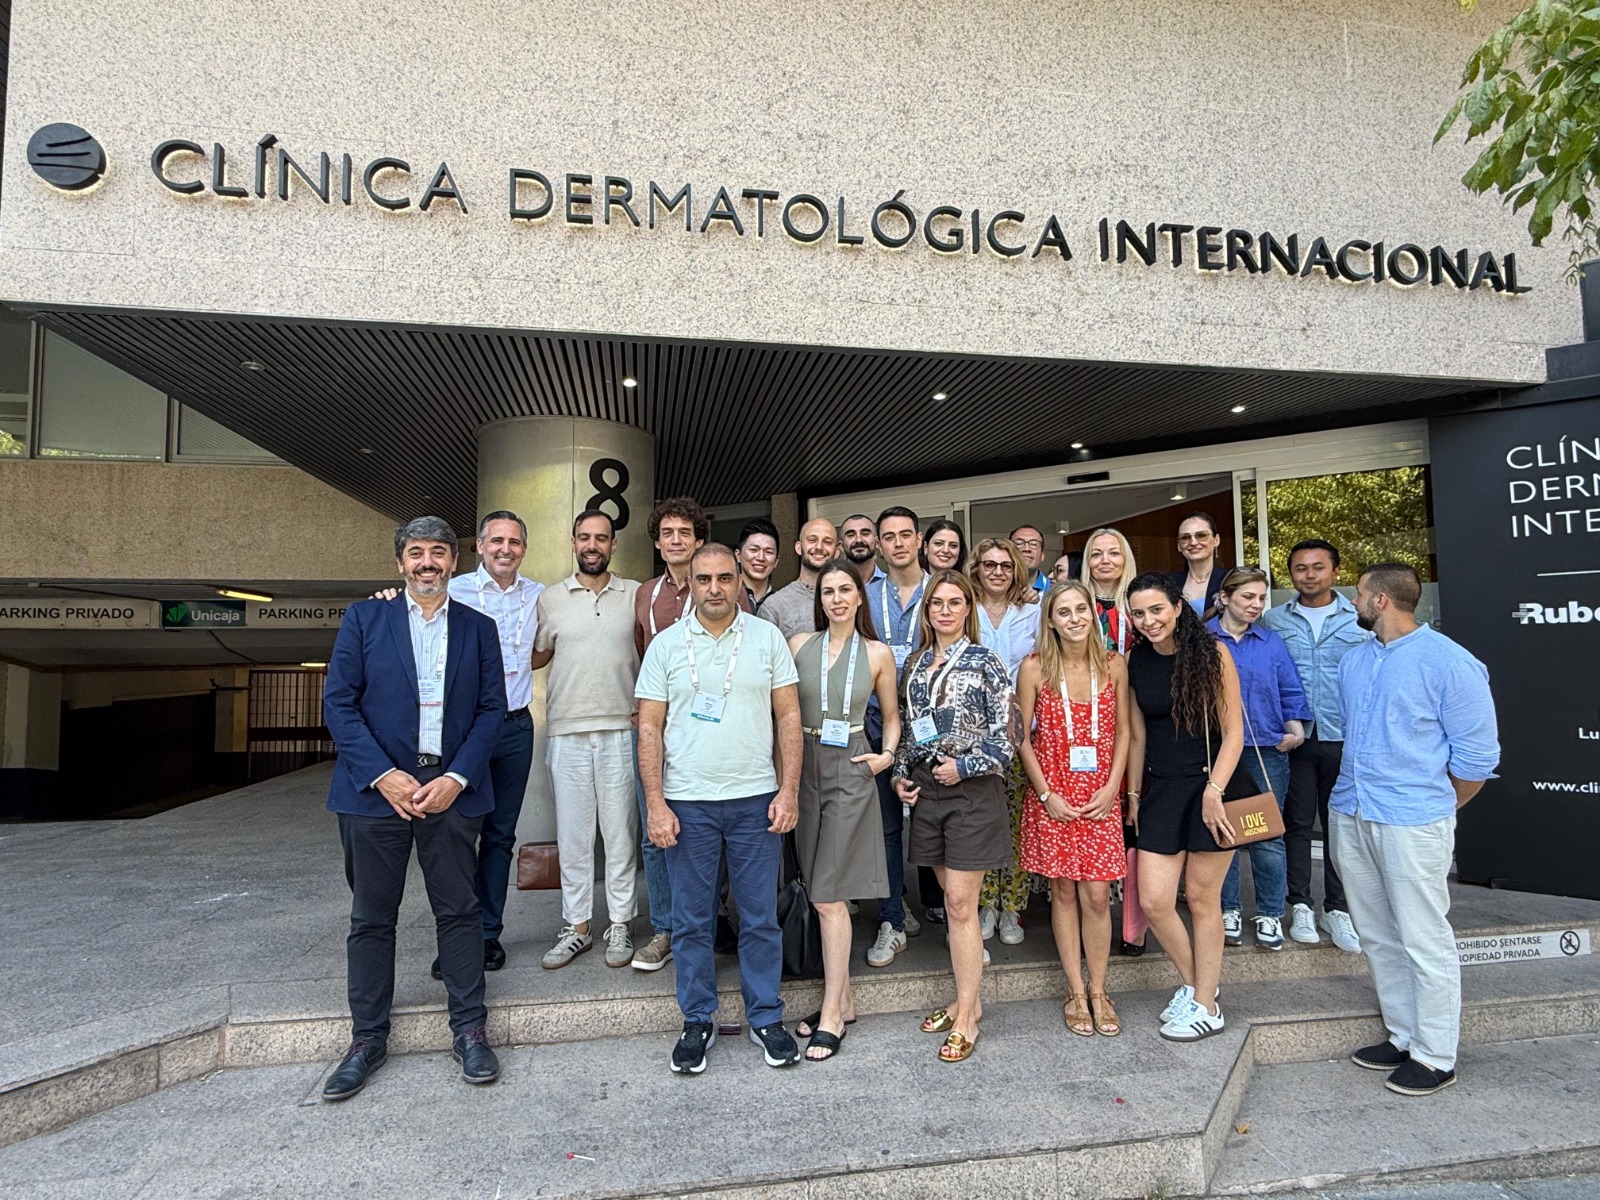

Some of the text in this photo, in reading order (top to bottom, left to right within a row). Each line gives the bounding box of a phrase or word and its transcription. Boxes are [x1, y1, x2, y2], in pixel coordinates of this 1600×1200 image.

[151, 134, 1532, 294] CLÍNICA DERMATOLÓGICA INTERNACIONAL
[584, 457, 630, 531] 8
[65, 608, 134, 619] PRIVADO
[191, 610, 240, 623] Unicaja
[258, 608, 324, 618] PARKING
[1579, 727, 1600, 739] Lu
[1532, 781, 1600, 793] www.cli
[1240, 811, 1266, 829] LOVE
[1500, 936, 1541, 947] SENTARSE
[1503, 949, 1540, 959] PRIVADA
